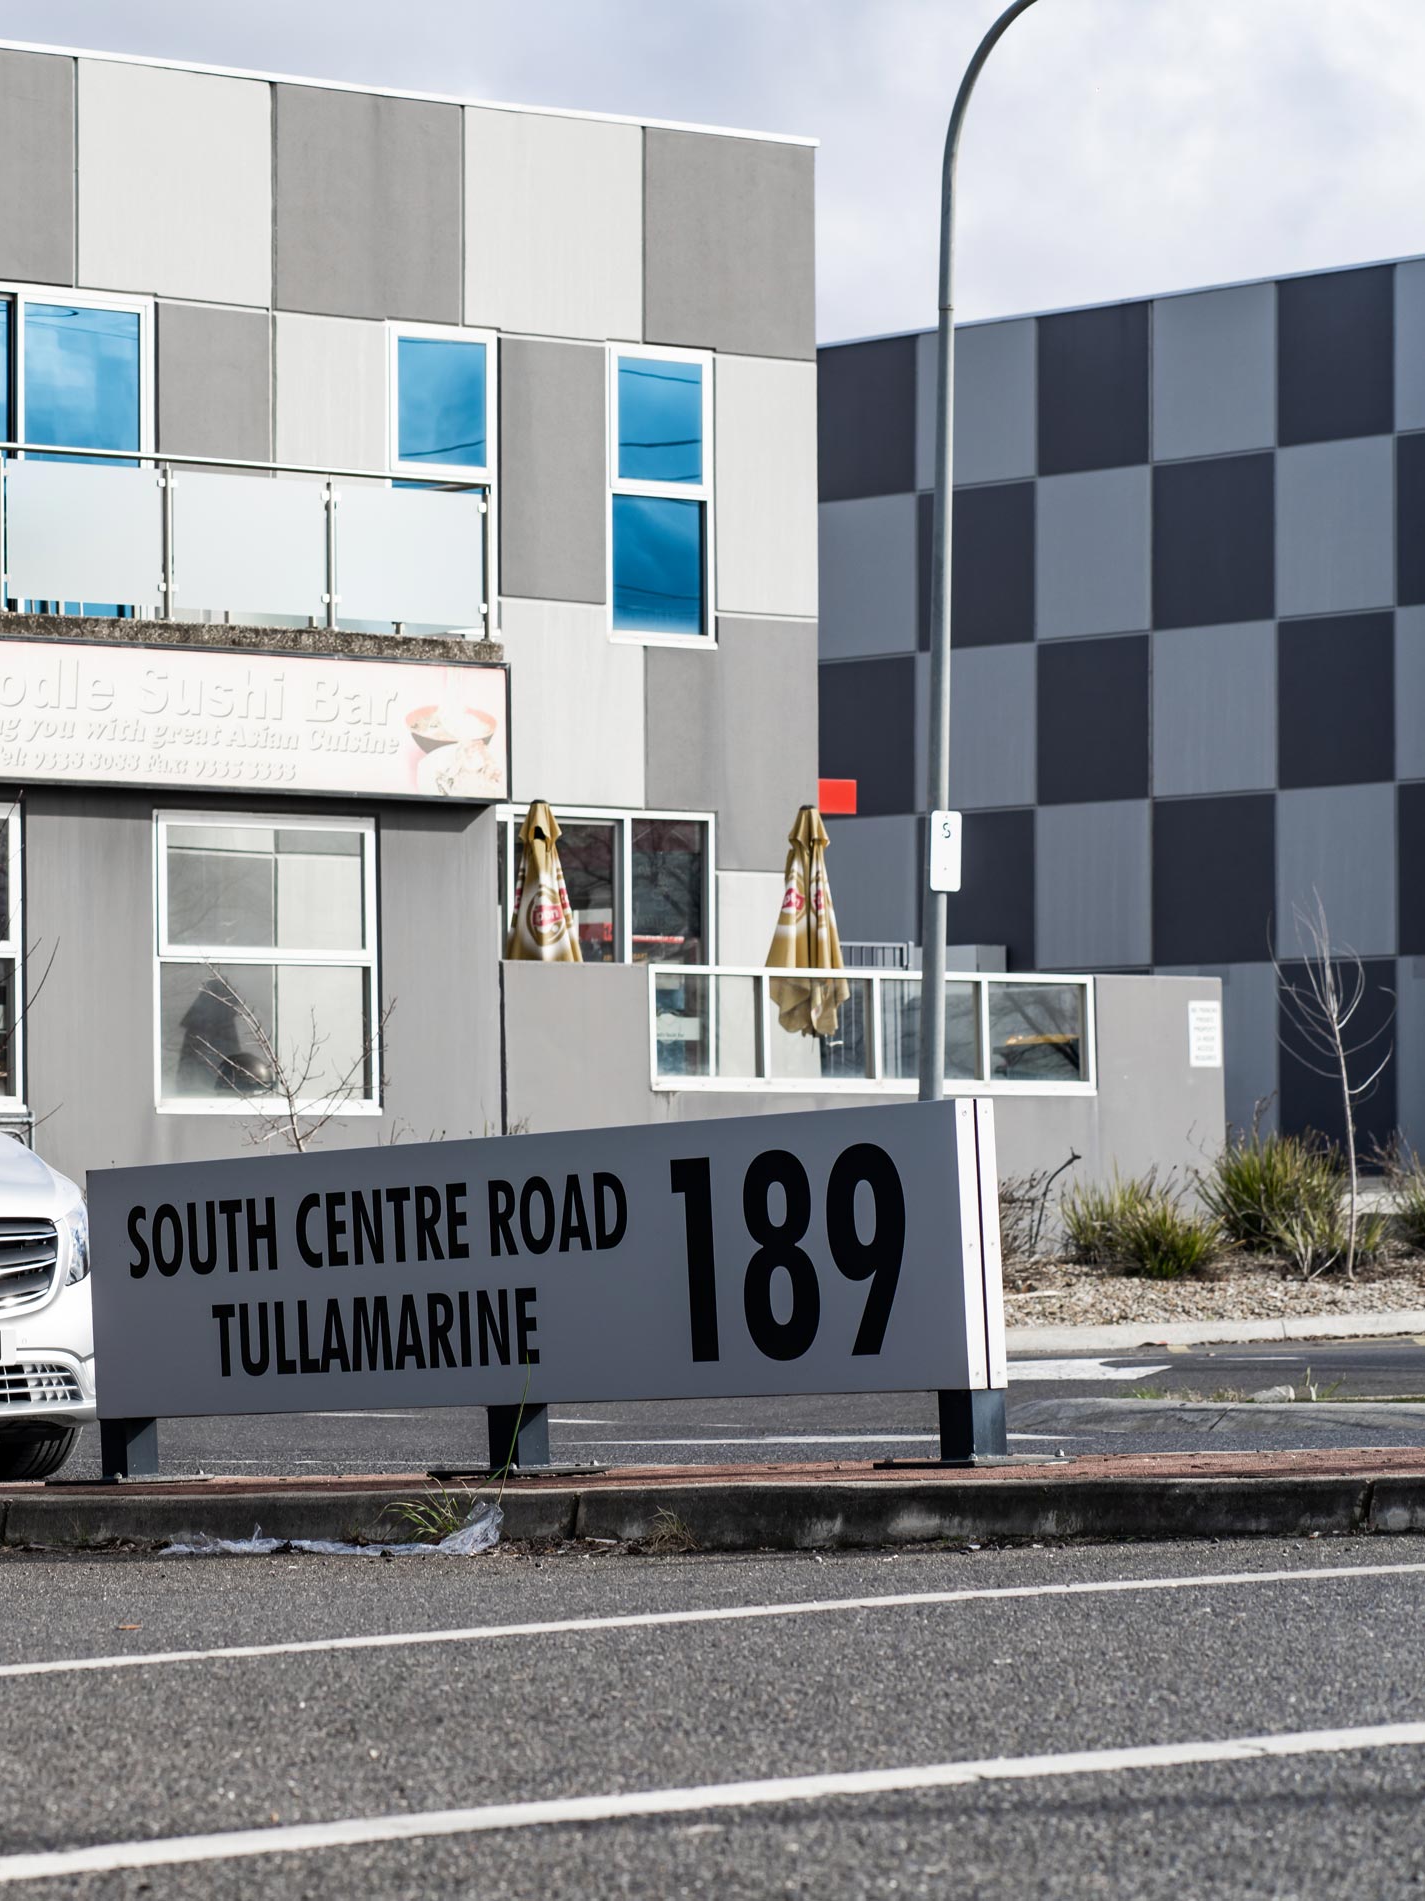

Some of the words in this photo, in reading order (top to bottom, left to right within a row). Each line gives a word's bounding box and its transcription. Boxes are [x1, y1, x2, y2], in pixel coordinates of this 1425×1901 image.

[30, 720, 77, 742] you
[86, 718, 146, 744] with
[151, 721, 220, 749] great
[226, 725, 300, 752] Asian
[310, 726, 400, 756] Cuisine
[137, 667, 285, 722] Sushi
[305, 679, 399, 727] Bar
[127, 1196, 277, 1280] SOUTH
[296, 1182, 470, 1270] CENTRE
[488, 1171, 629, 1257] ROAD
[670, 1142, 906, 1363] 189
[212, 1286, 541, 1378] TULLAMARINE
